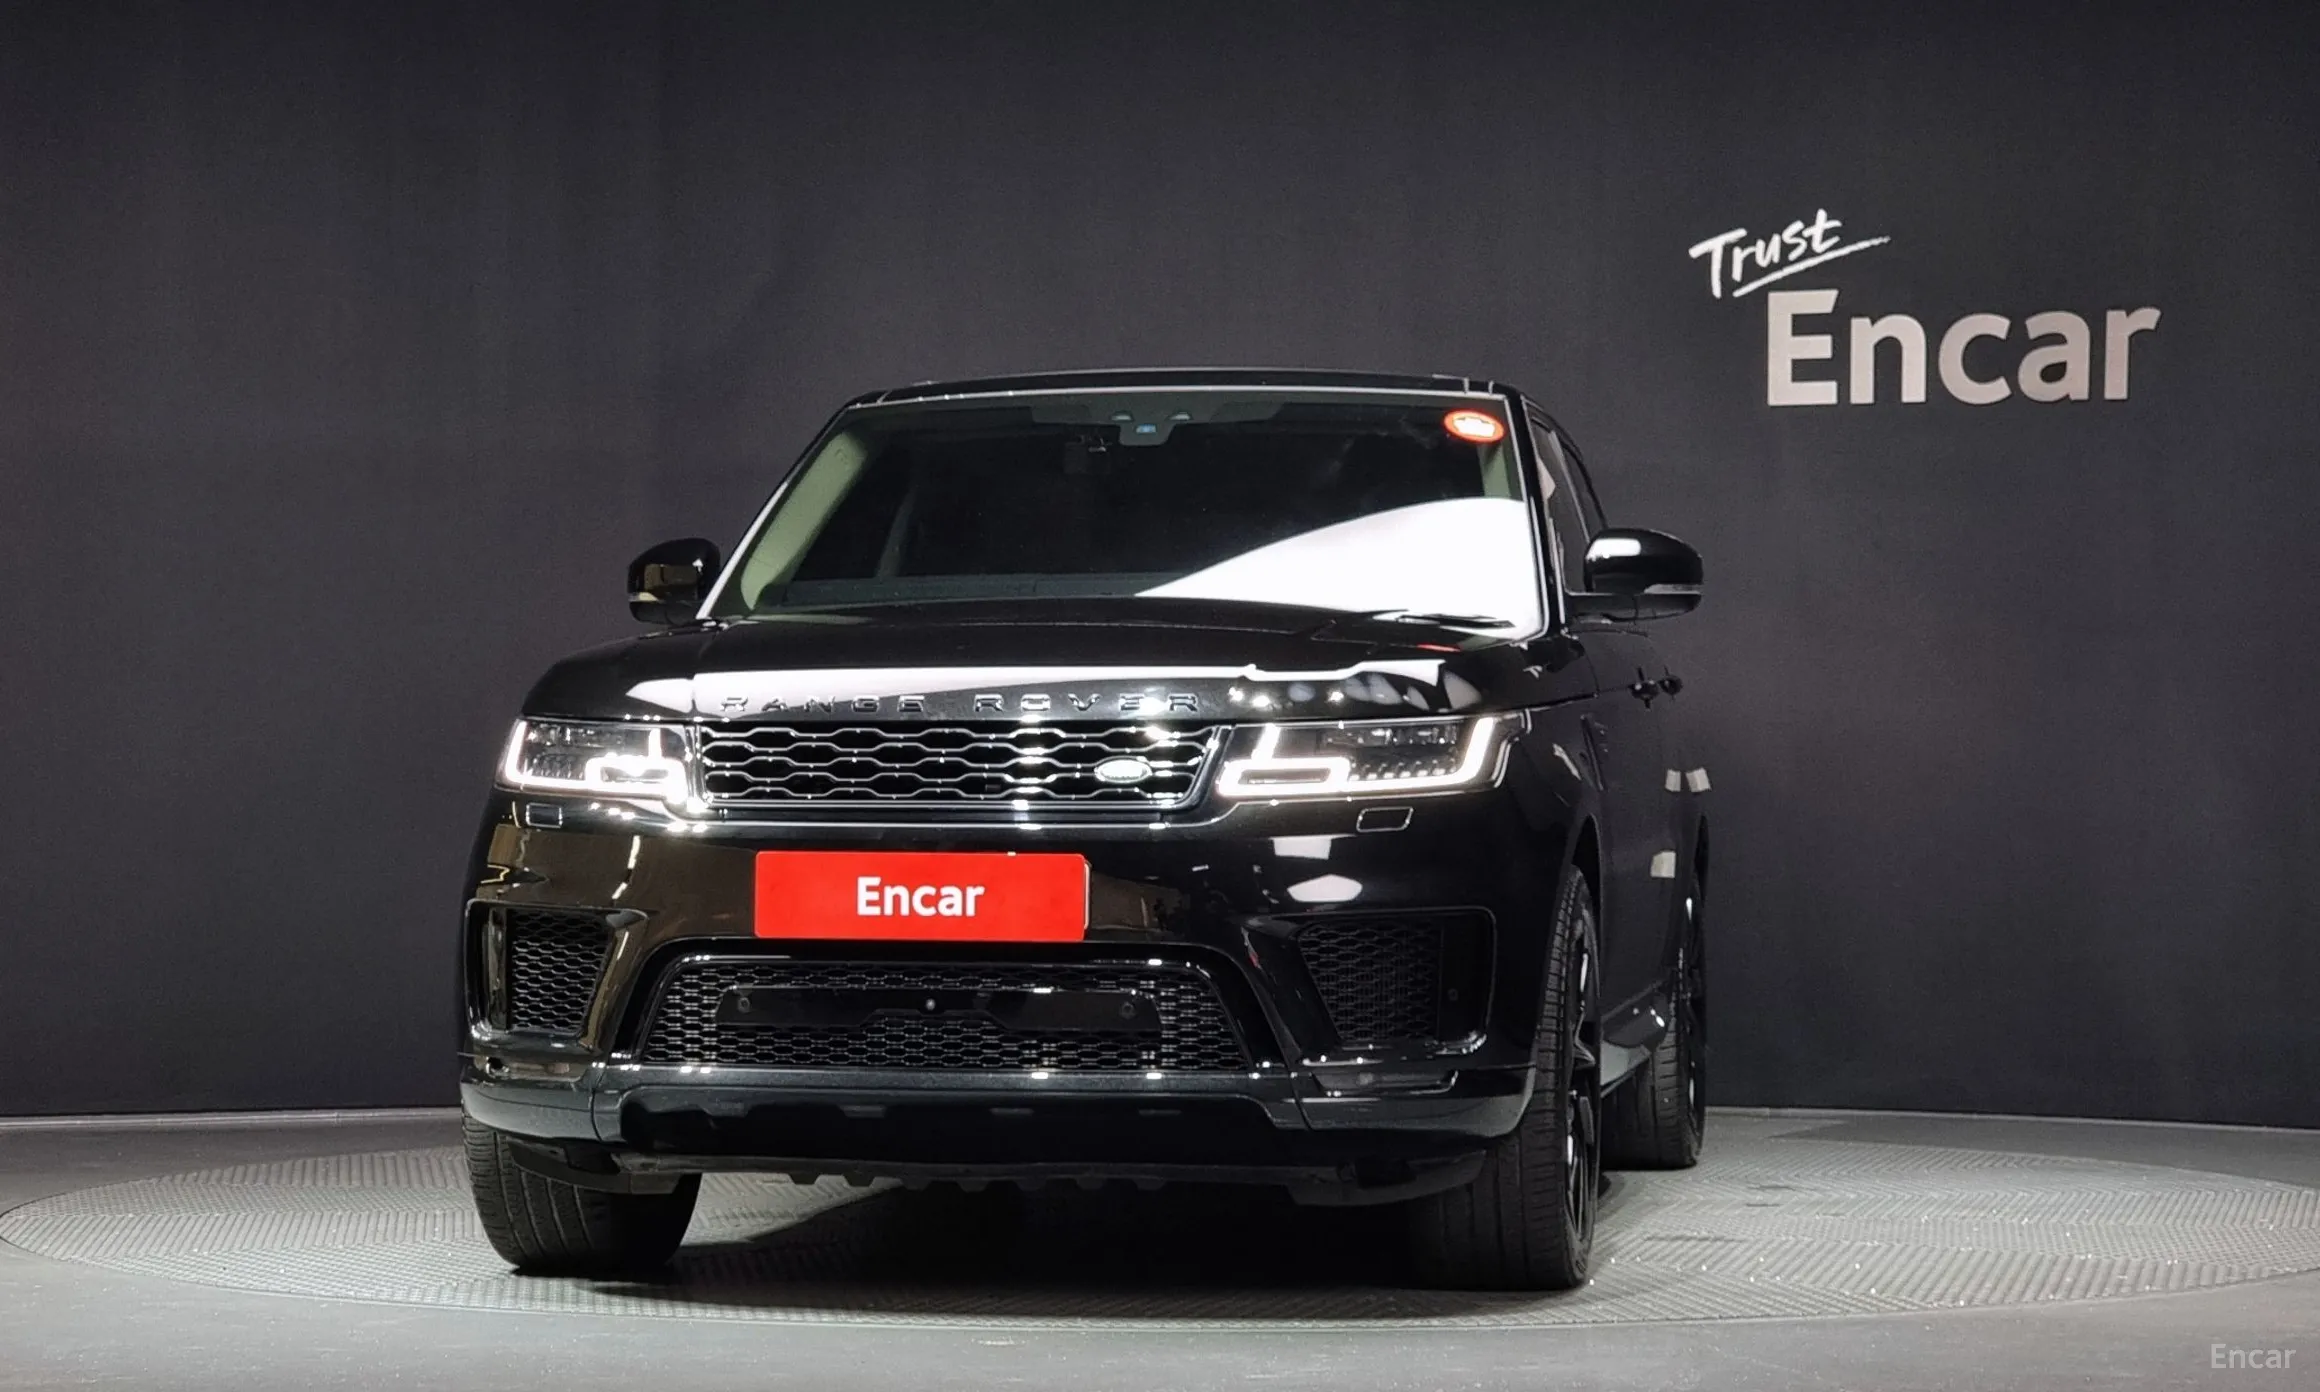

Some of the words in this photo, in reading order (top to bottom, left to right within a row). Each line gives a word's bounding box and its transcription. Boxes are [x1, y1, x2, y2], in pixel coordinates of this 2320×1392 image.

[1689, 209, 1842, 298] Trust
[1767, 289, 2161, 406] Encar
[720, 694, 925, 713] RANGE
[974, 693, 1198, 712] ROVER
[857, 876, 985, 917] Encar
